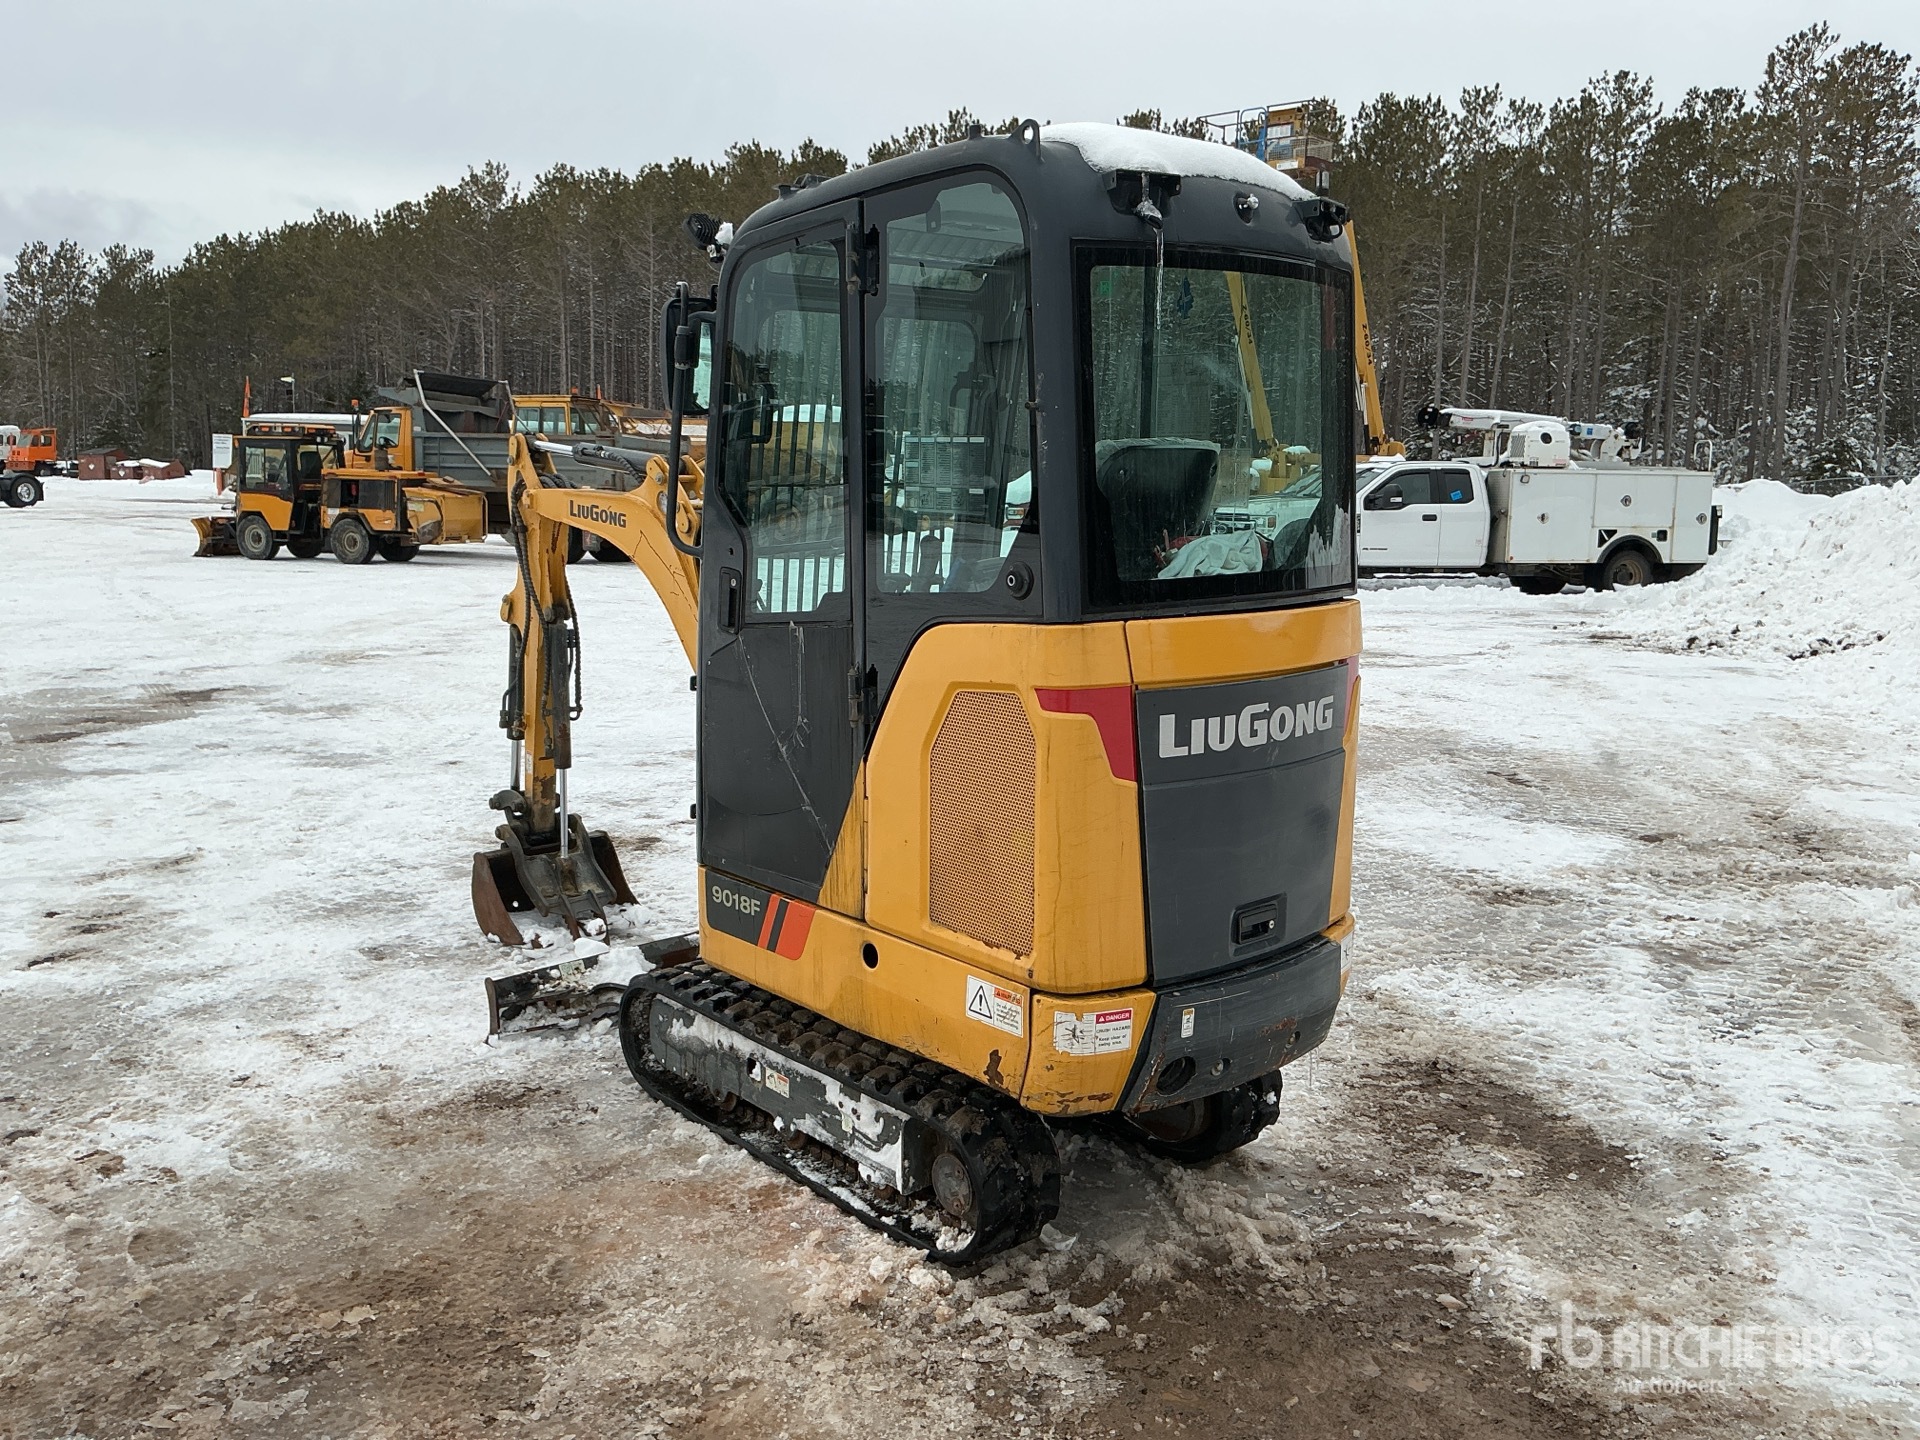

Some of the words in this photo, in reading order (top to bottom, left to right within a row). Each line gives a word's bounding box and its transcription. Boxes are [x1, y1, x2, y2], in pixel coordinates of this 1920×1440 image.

[1362, 323, 1372, 366] Z-60/34
[712, 885, 760, 916] 9018F
[1105, 1012, 1130, 1021] DANGER
